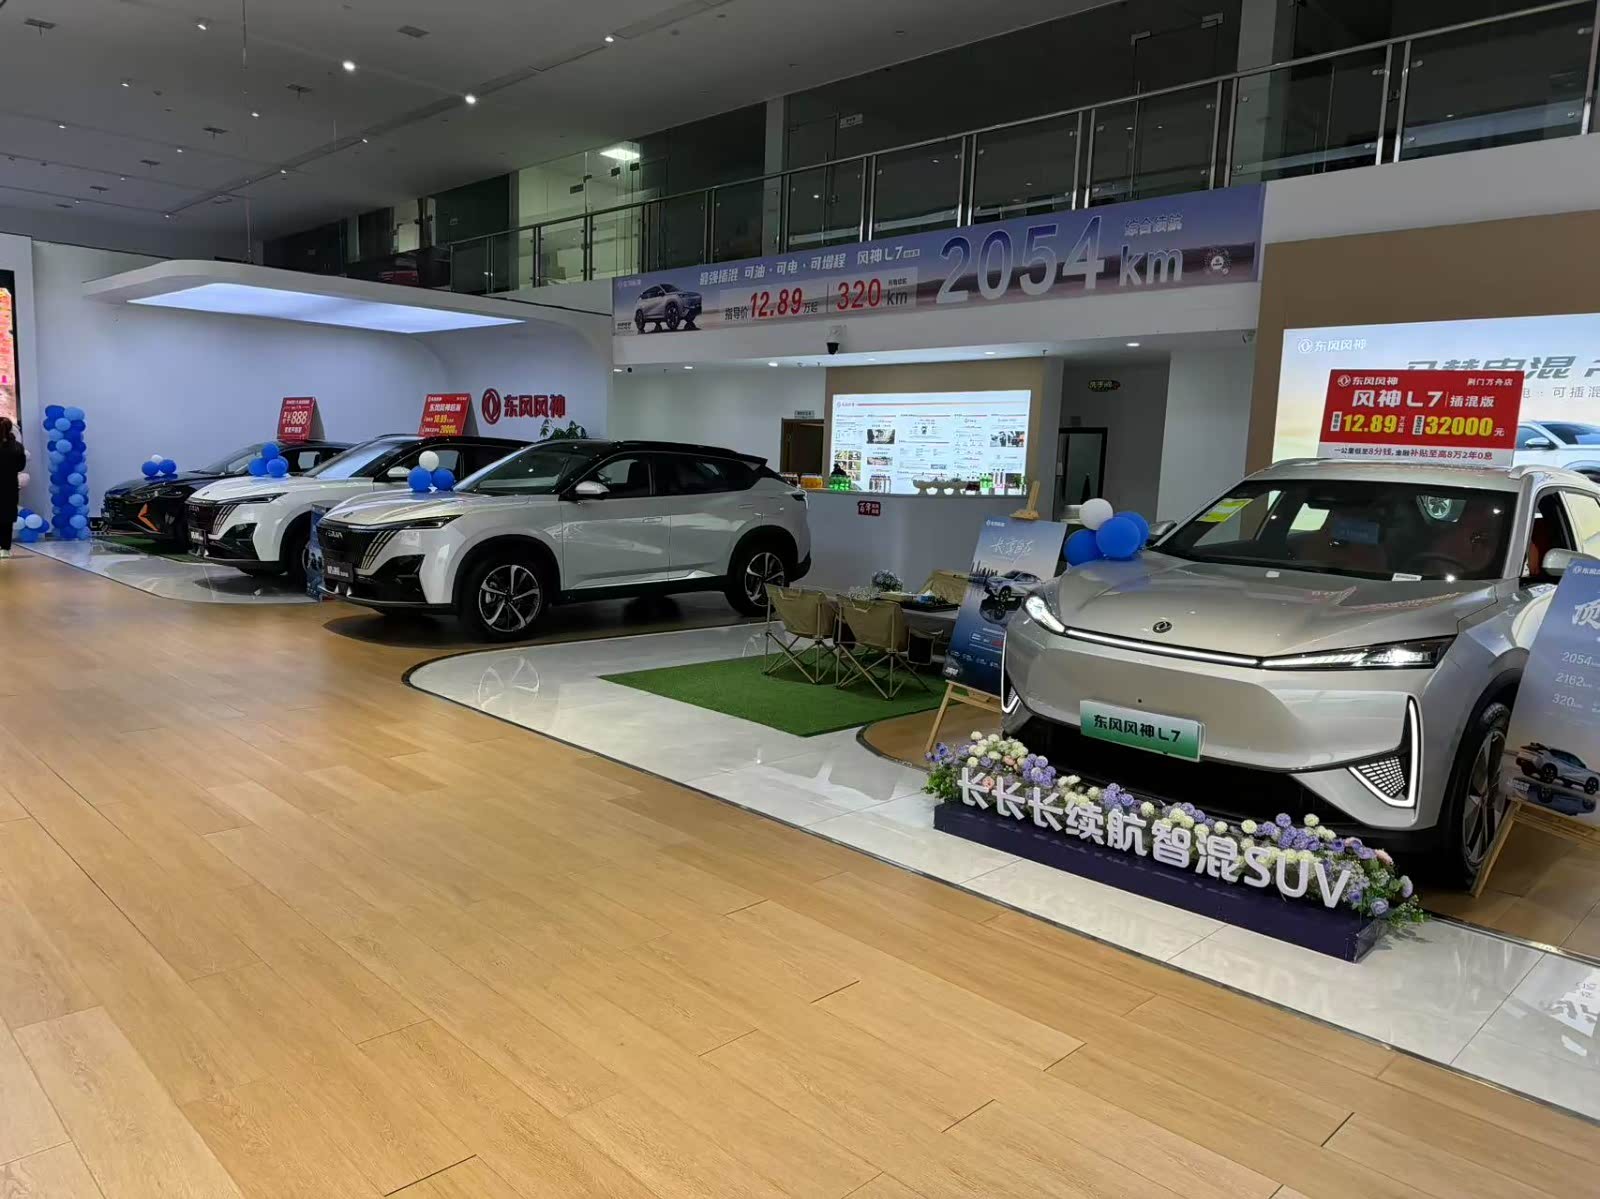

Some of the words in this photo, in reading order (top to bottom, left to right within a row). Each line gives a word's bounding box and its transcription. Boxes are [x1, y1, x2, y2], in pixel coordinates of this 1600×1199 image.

[936, 215, 1105, 304] 2054
[1119, 244, 1184, 287] km
[725, 305, 749, 320] 指导价
[750, 287, 803, 318] 12.89
[837, 278, 882, 310] 320
[887, 289, 908, 305] km
[1314, 338, 1368, 353] 东风风神
[1352, 376, 1399, 386] 东风风神
[504, 394, 566, 418] 东风风神
[1352, 389, 1443, 408] 风神L7
[1450, 395, 1495, 408] 插混版
[1343, 414, 1397, 433] 12.89
[1425, 416, 1493, 436] 32000
[1493, 427, 1505, 437] 元
[1561, 651, 1592, 667] 2054
[1552, 692, 1575, 708] 320
[1093, 713, 1181, 743] 东风风神L7
[957, 766, 1352, 909] 长长长续航智混SUV
